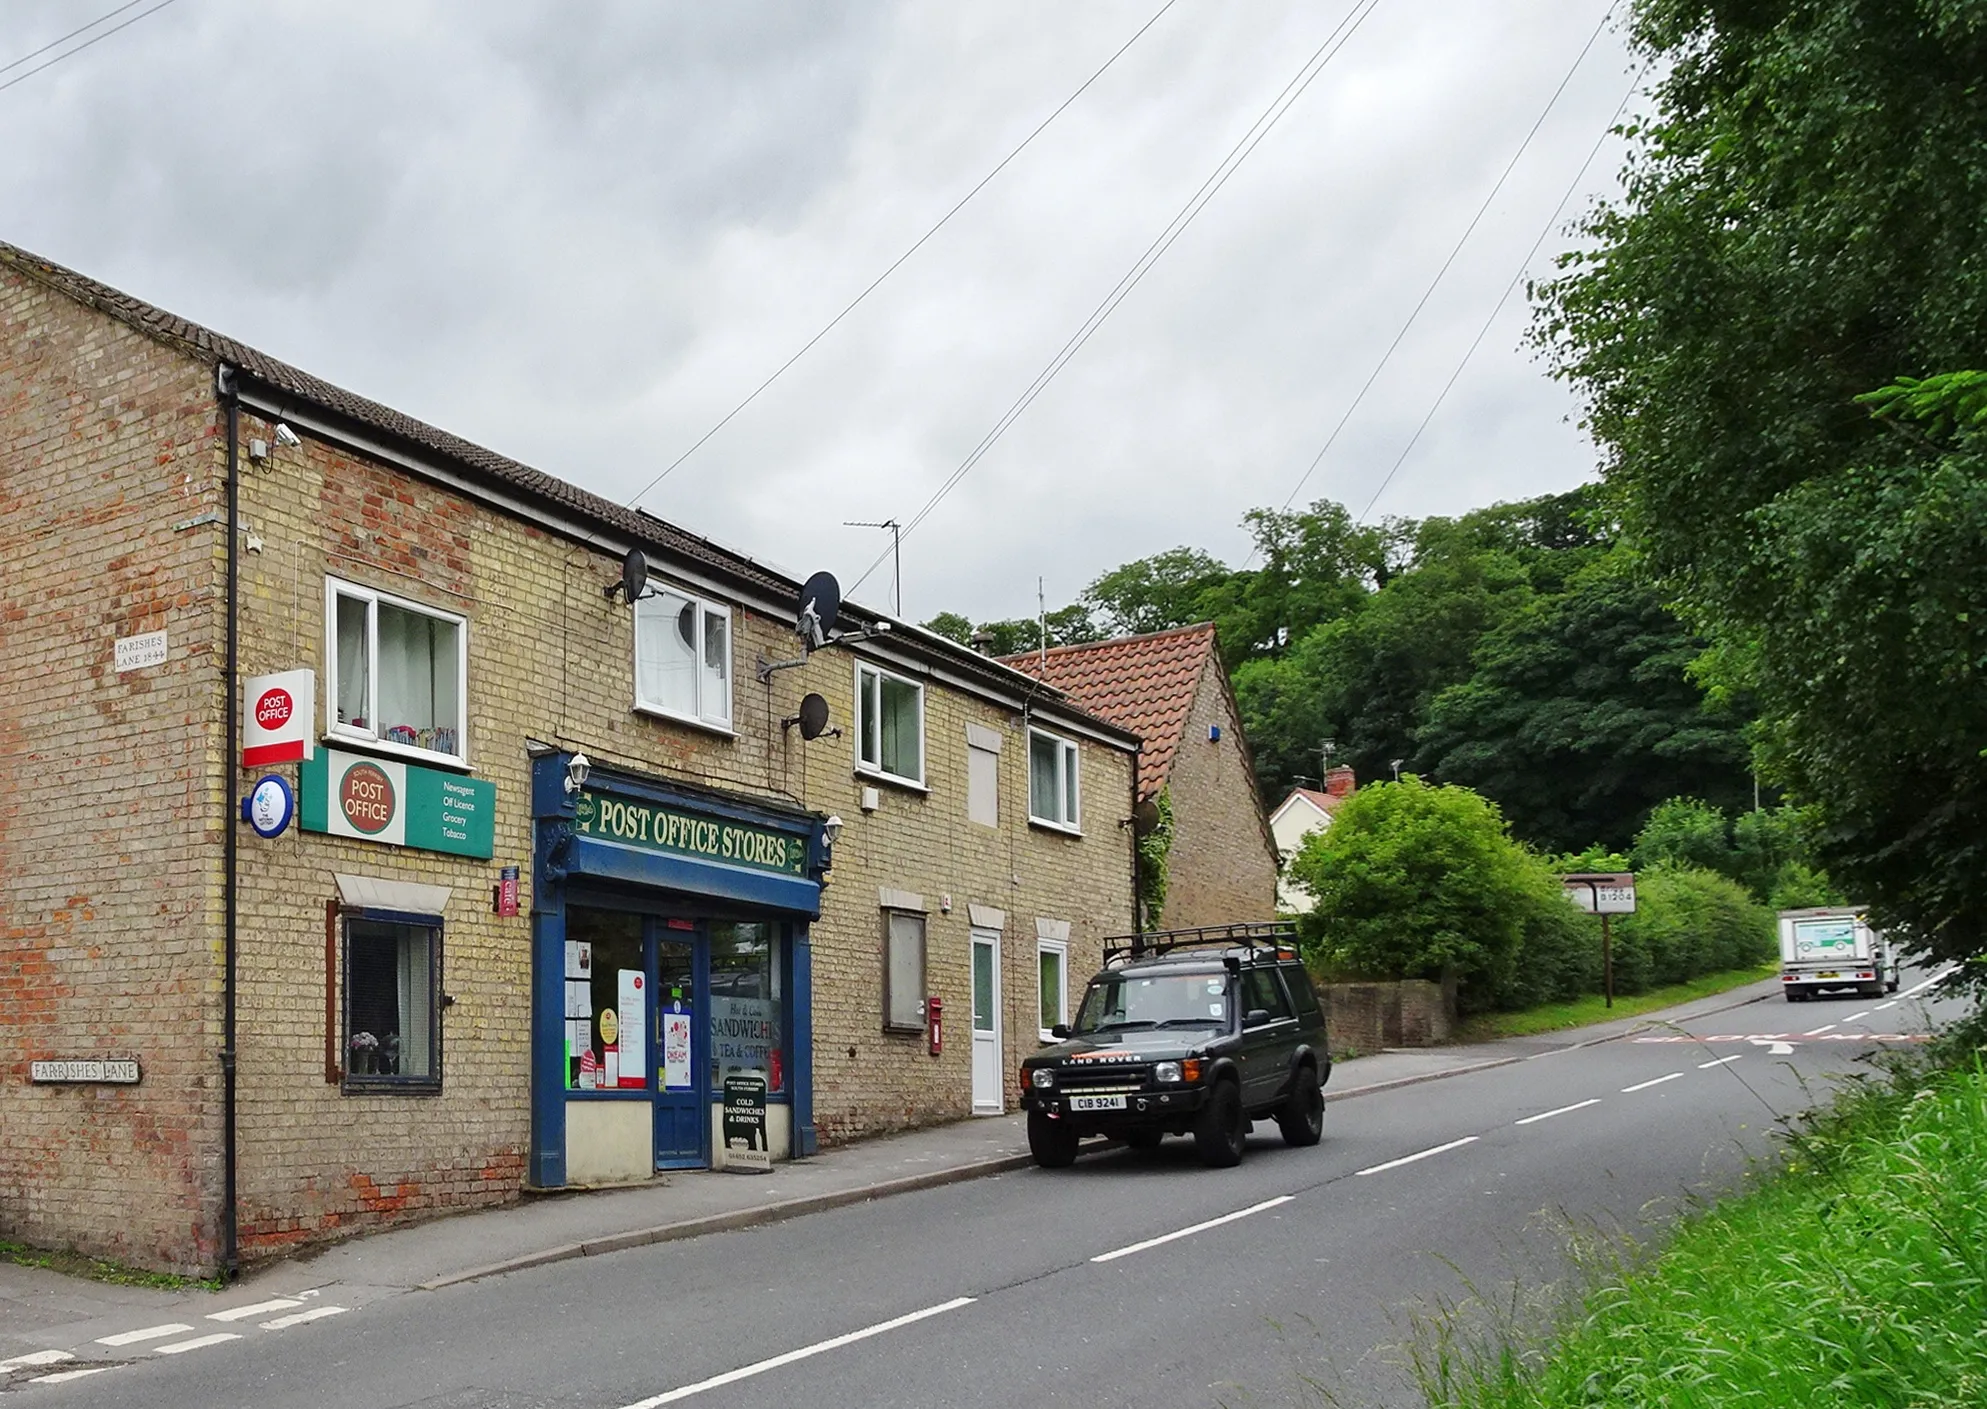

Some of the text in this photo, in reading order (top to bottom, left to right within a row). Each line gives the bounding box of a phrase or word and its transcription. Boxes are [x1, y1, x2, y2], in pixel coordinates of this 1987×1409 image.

[117, 636, 162, 654] FARISHES
[117, 654, 140, 668] LANE
[263, 695, 286, 709] POST
[258, 706, 289, 722] OFFICE
[351, 779, 384, 801] POST
[443, 781, 475, 797] Newsagent
[345, 798, 388, 822] OFFICE
[443, 796, 475, 812] Off Licence
[442, 811, 467, 827] Grocery
[442, 826, 467, 840] Tobacco
[600, 799, 786, 868] POST OFFICE STORES
[1062, 1055, 1142, 1066] LAND ROVER
[35, 1063, 134, 1079] FARRISHES LANE
[736, 1098, 754, 1106] COLD
[1078, 1097, 1119, 1109] CIB 9241
[725, 1106, 765, 1116] SANDWICHES
[736, 1115, 759, 1124] DRINKS
